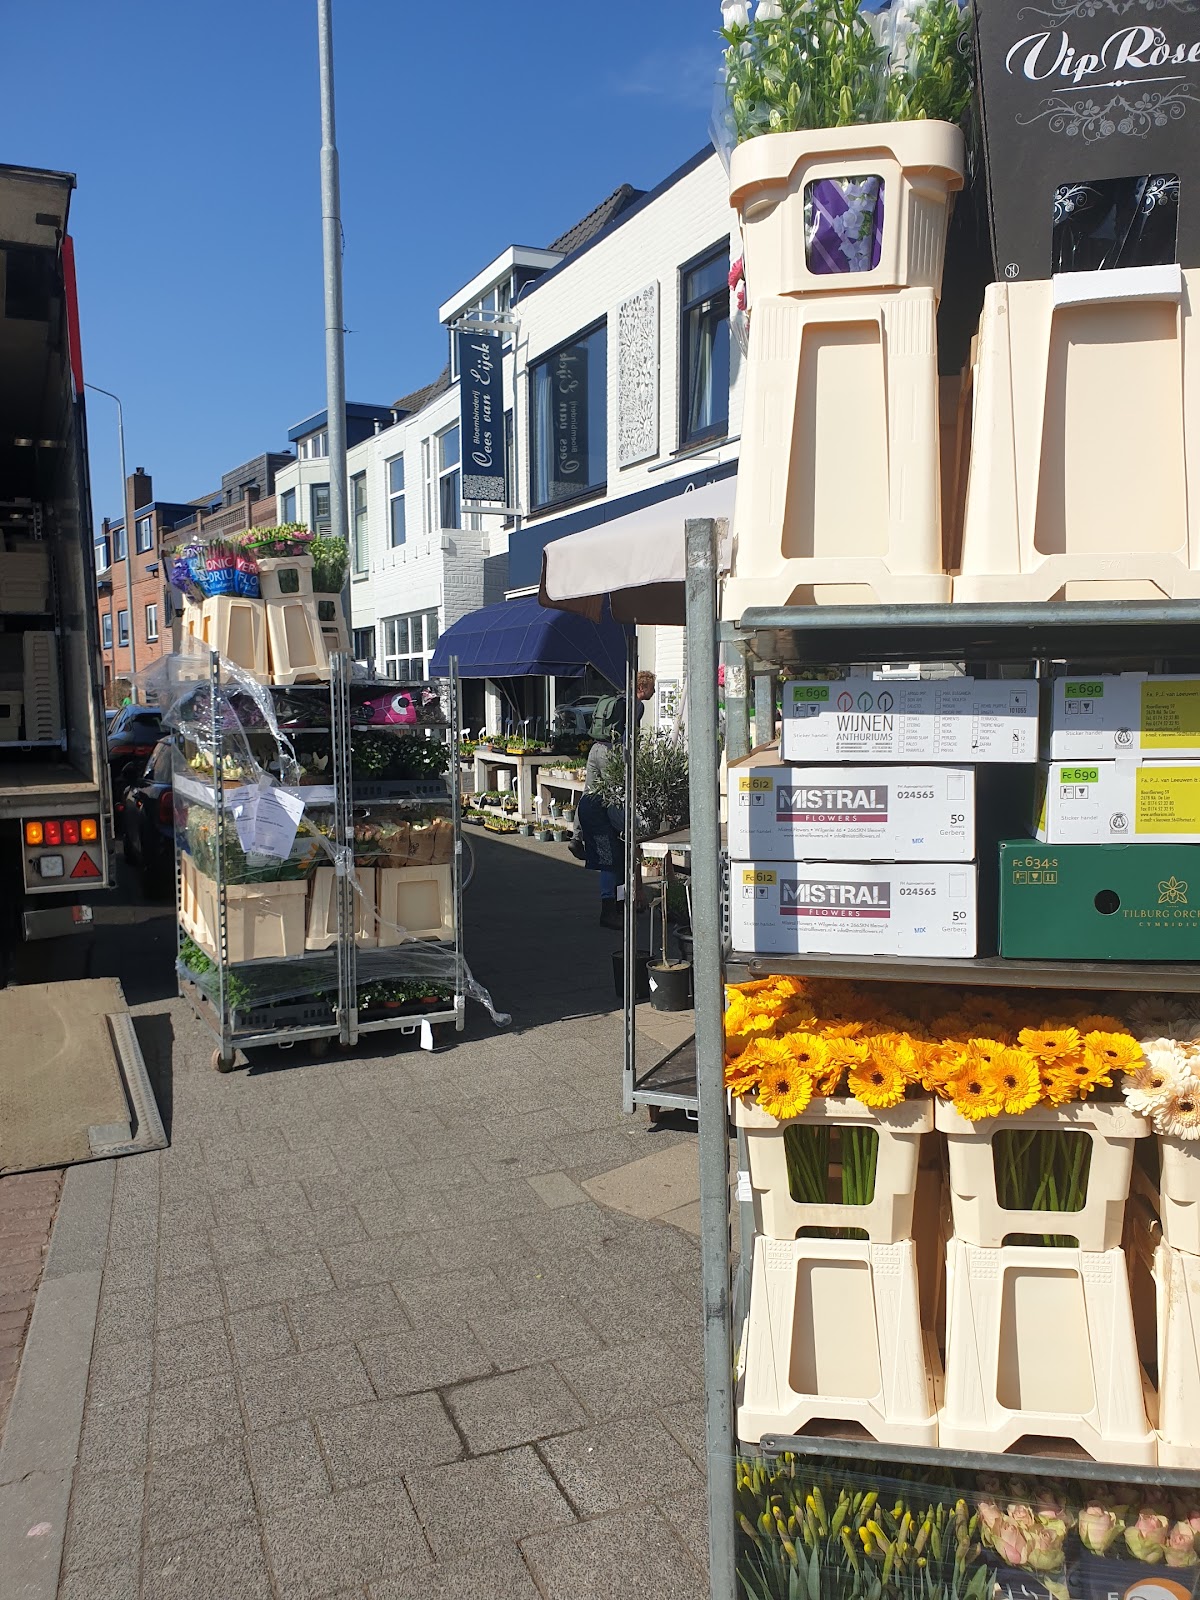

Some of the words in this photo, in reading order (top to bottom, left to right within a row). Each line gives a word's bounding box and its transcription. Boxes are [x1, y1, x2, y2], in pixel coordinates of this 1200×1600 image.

[470, 344, 494, 386] Eijck
[483, 393, 492, 422] van
[472, 390, 480, 444] Bloembinderij
[472, 431, 492, 468] Cees
[806, 688, 828, 700] 690
[1079, 684, 1102, 696] 690
[837, 715, 893, 732] WIJNEN
[1074, 769, 1097, 781] 690
[752, 779, 769, 789] 612
[780, 789, 885, 809] MISTRAL
[950, 814, 965, 824] 50
[1025, 856, 1058, 869] 634-S
[756, 872, 773, 881] 612
[784, 883, 887, 904] MISTRAL
[952, 911, 966, 921] 50
[1123, 910, 1170, 918] TILBURG
